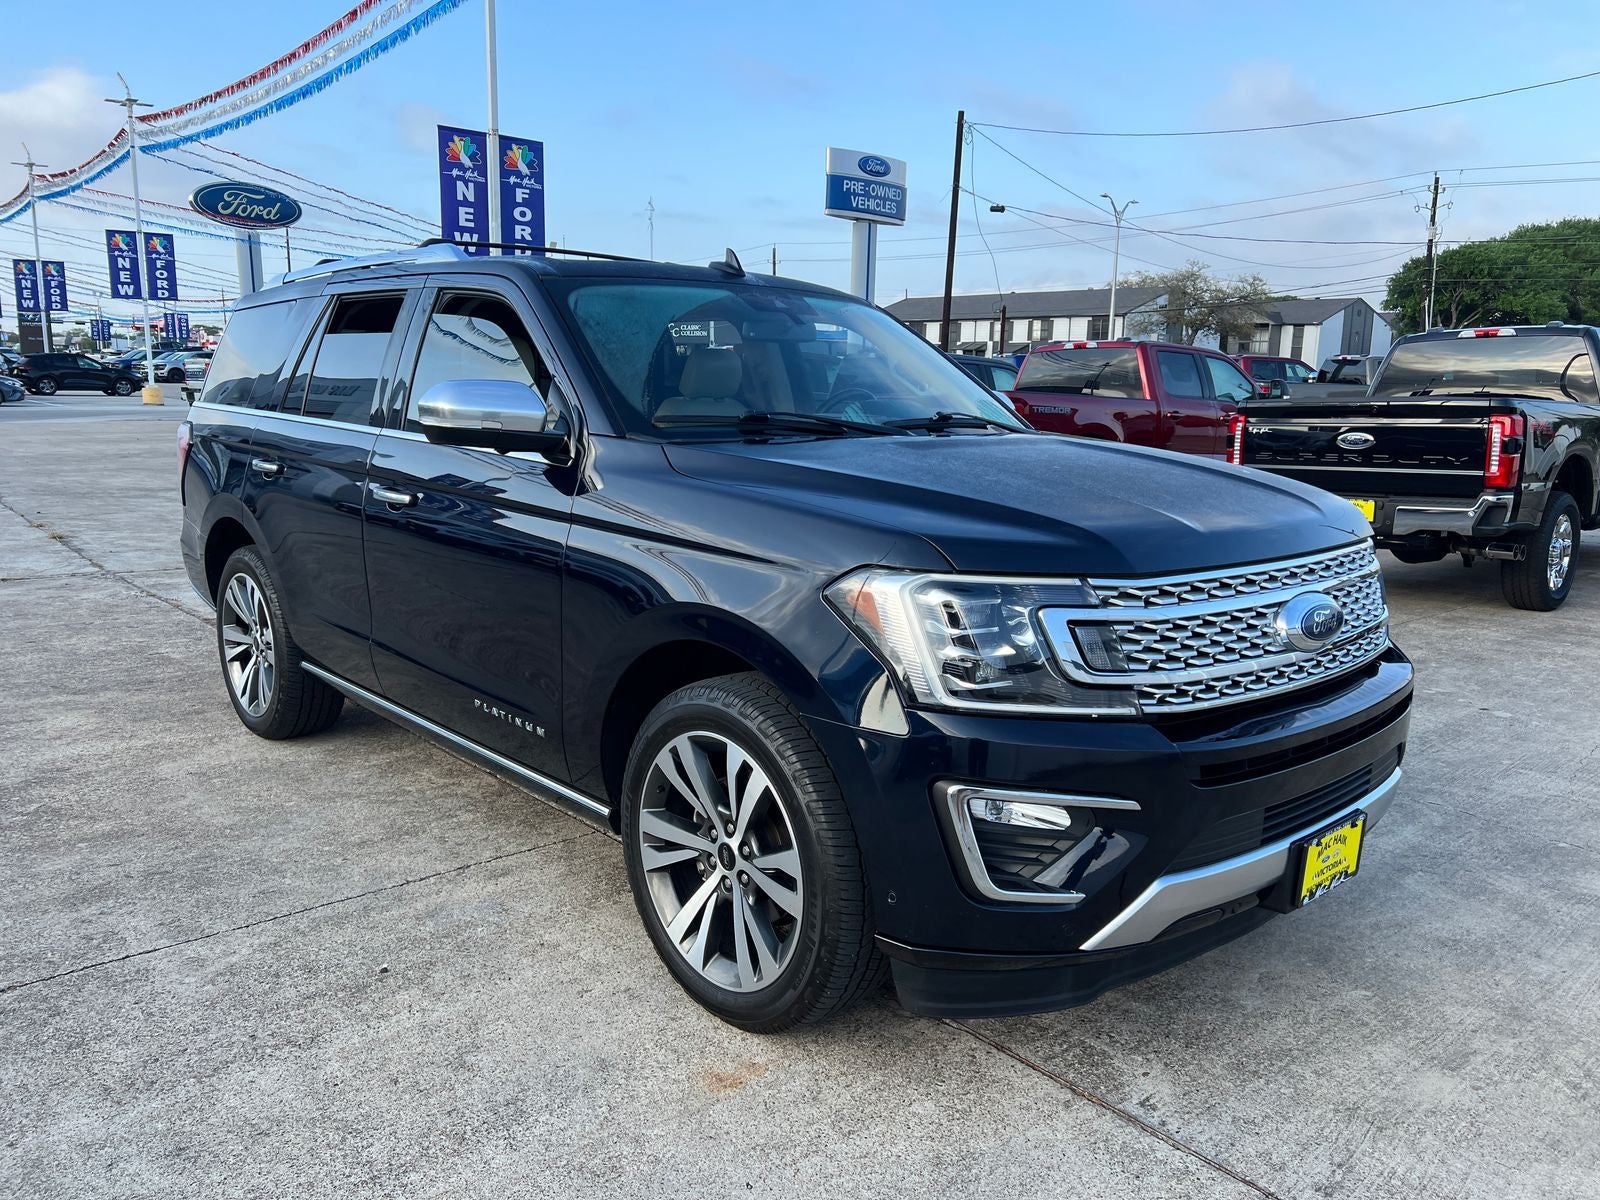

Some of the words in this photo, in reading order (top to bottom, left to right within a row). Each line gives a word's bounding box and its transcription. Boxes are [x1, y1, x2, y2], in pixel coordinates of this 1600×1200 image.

[866, 159, 886, 173] Ford
[843, 180, 901, 200] PRE-OWNED
[851, 195, 897, 214] VEHICLES
[217, 190, 281, 220] Ford
[454, 180, 478, 253] NEW
[117, 257, 134, 296] NEW
[155, 259, 169, 298] FORD
[21, 279, 34, 308] NEW
[50, 280, 61, 310] FORD
[1032, 405, 1072, 414] TREMOR
[1313, 608, 1340, 635] Ford
[474, 698, 545, 738] PLATINUM
[1317, 838, 1333, 861] MAC
